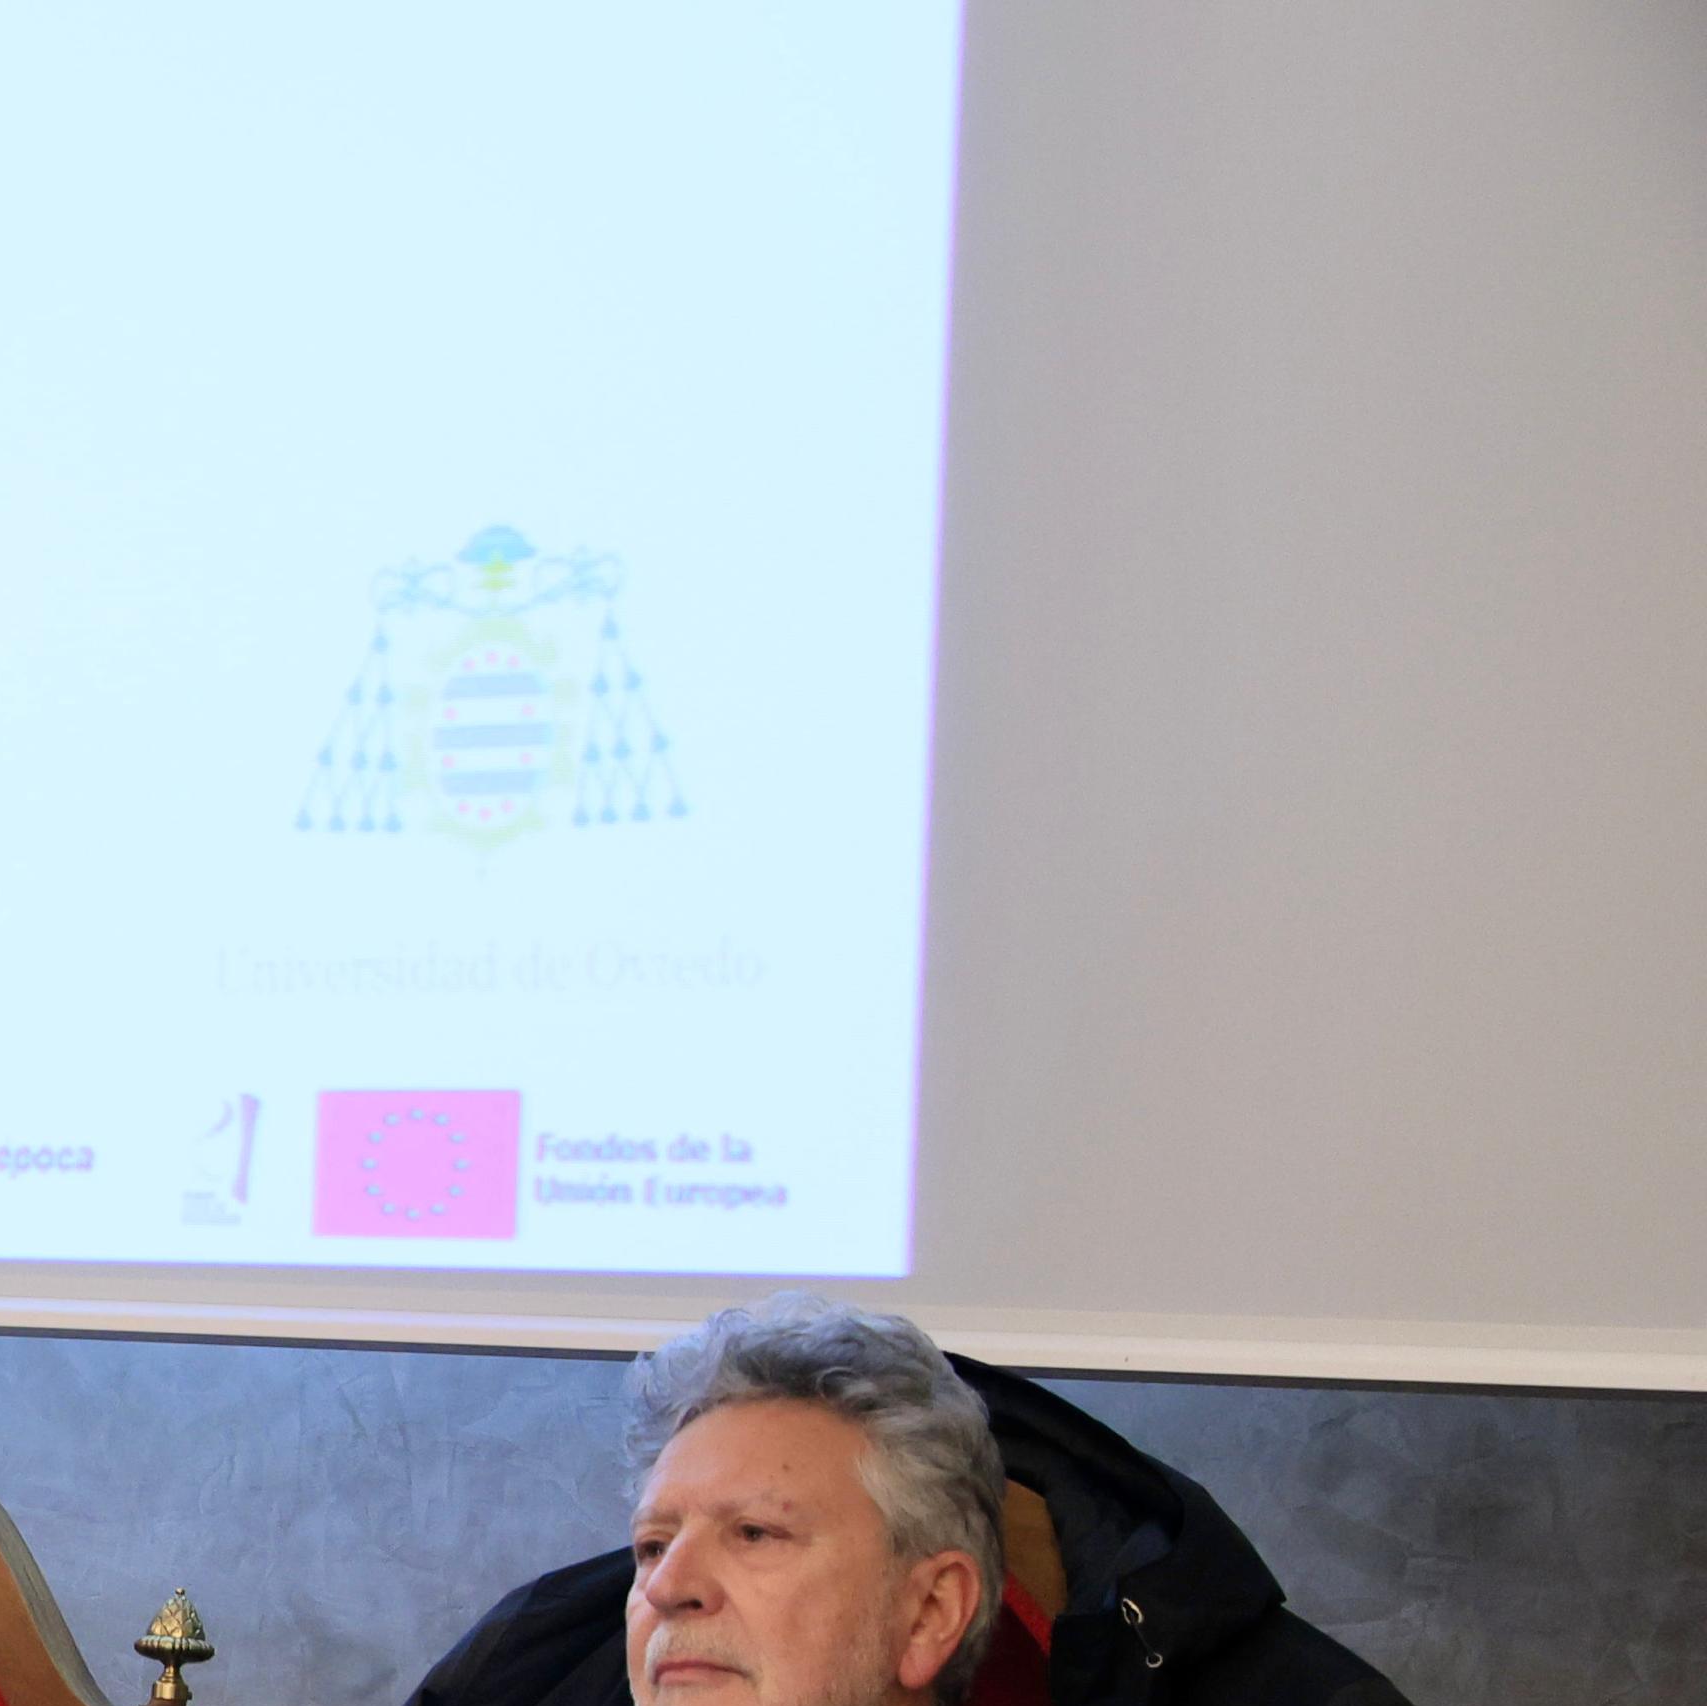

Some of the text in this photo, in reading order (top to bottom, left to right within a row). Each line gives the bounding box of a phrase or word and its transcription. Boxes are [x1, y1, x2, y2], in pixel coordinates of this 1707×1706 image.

[536, 1131, 754, 1163] Fondos de la
[644, 1176, 789, 1211] Europea
